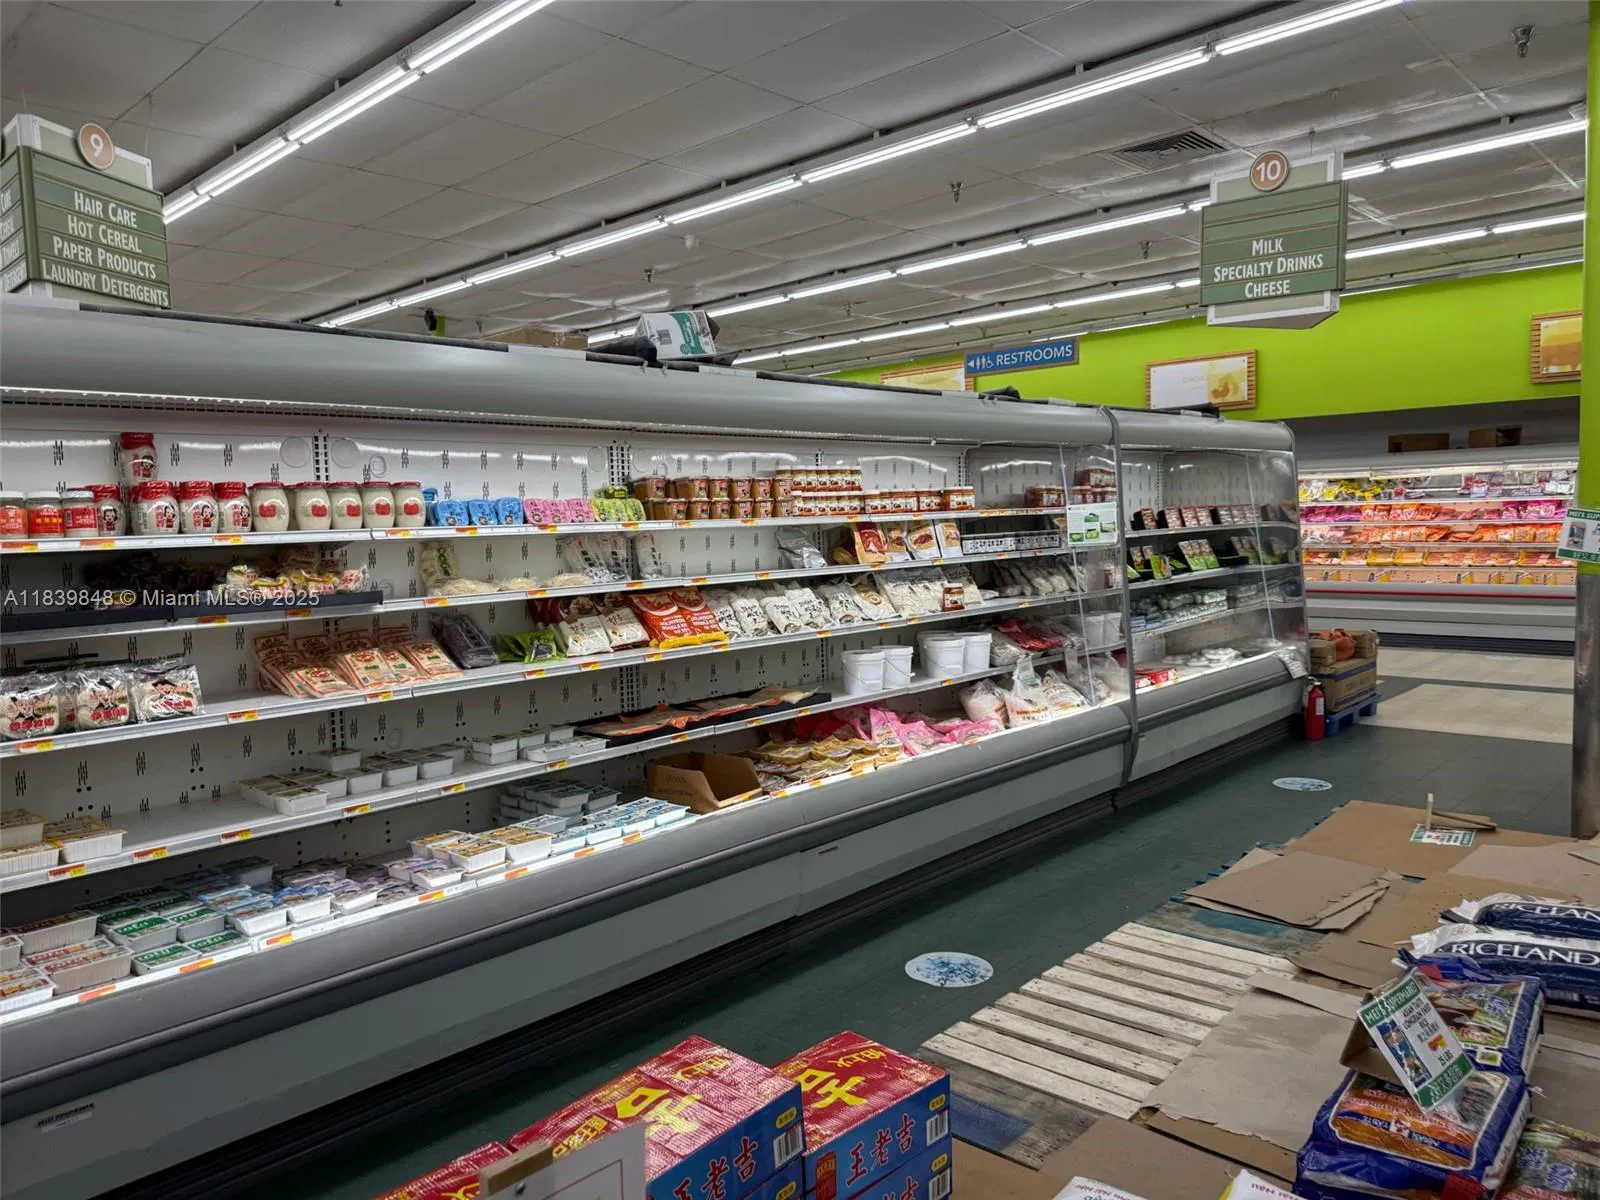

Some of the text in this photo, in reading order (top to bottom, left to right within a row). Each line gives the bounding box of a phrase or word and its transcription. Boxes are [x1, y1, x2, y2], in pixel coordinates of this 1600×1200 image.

[90, 134, 104, 157] 9
[1256, 160, 1281, 182] 10
[74, 191, 138, 229] HAIR CARE
[68, 214, 143, 254] HOT CEREAL
[1252, 238, 1284, 257] MILK
[53, 236, 93, 263] PAPER
[97, 247, 157, 280] PRODUCTS
[1213, 253, 1324, 283] SPECIALTY DRINKS
[42, 259, 97, 291] LAUNDRY
[101, 275, 169, 307] DETERGENTS
[1244, 279, 1291, 299] CHEESE
[996, 344, 1073, 367] RESTROOMS
[1451, 942, 1600, 967] RICELAND
[845, 1112, 916, 1188] 王老吉
